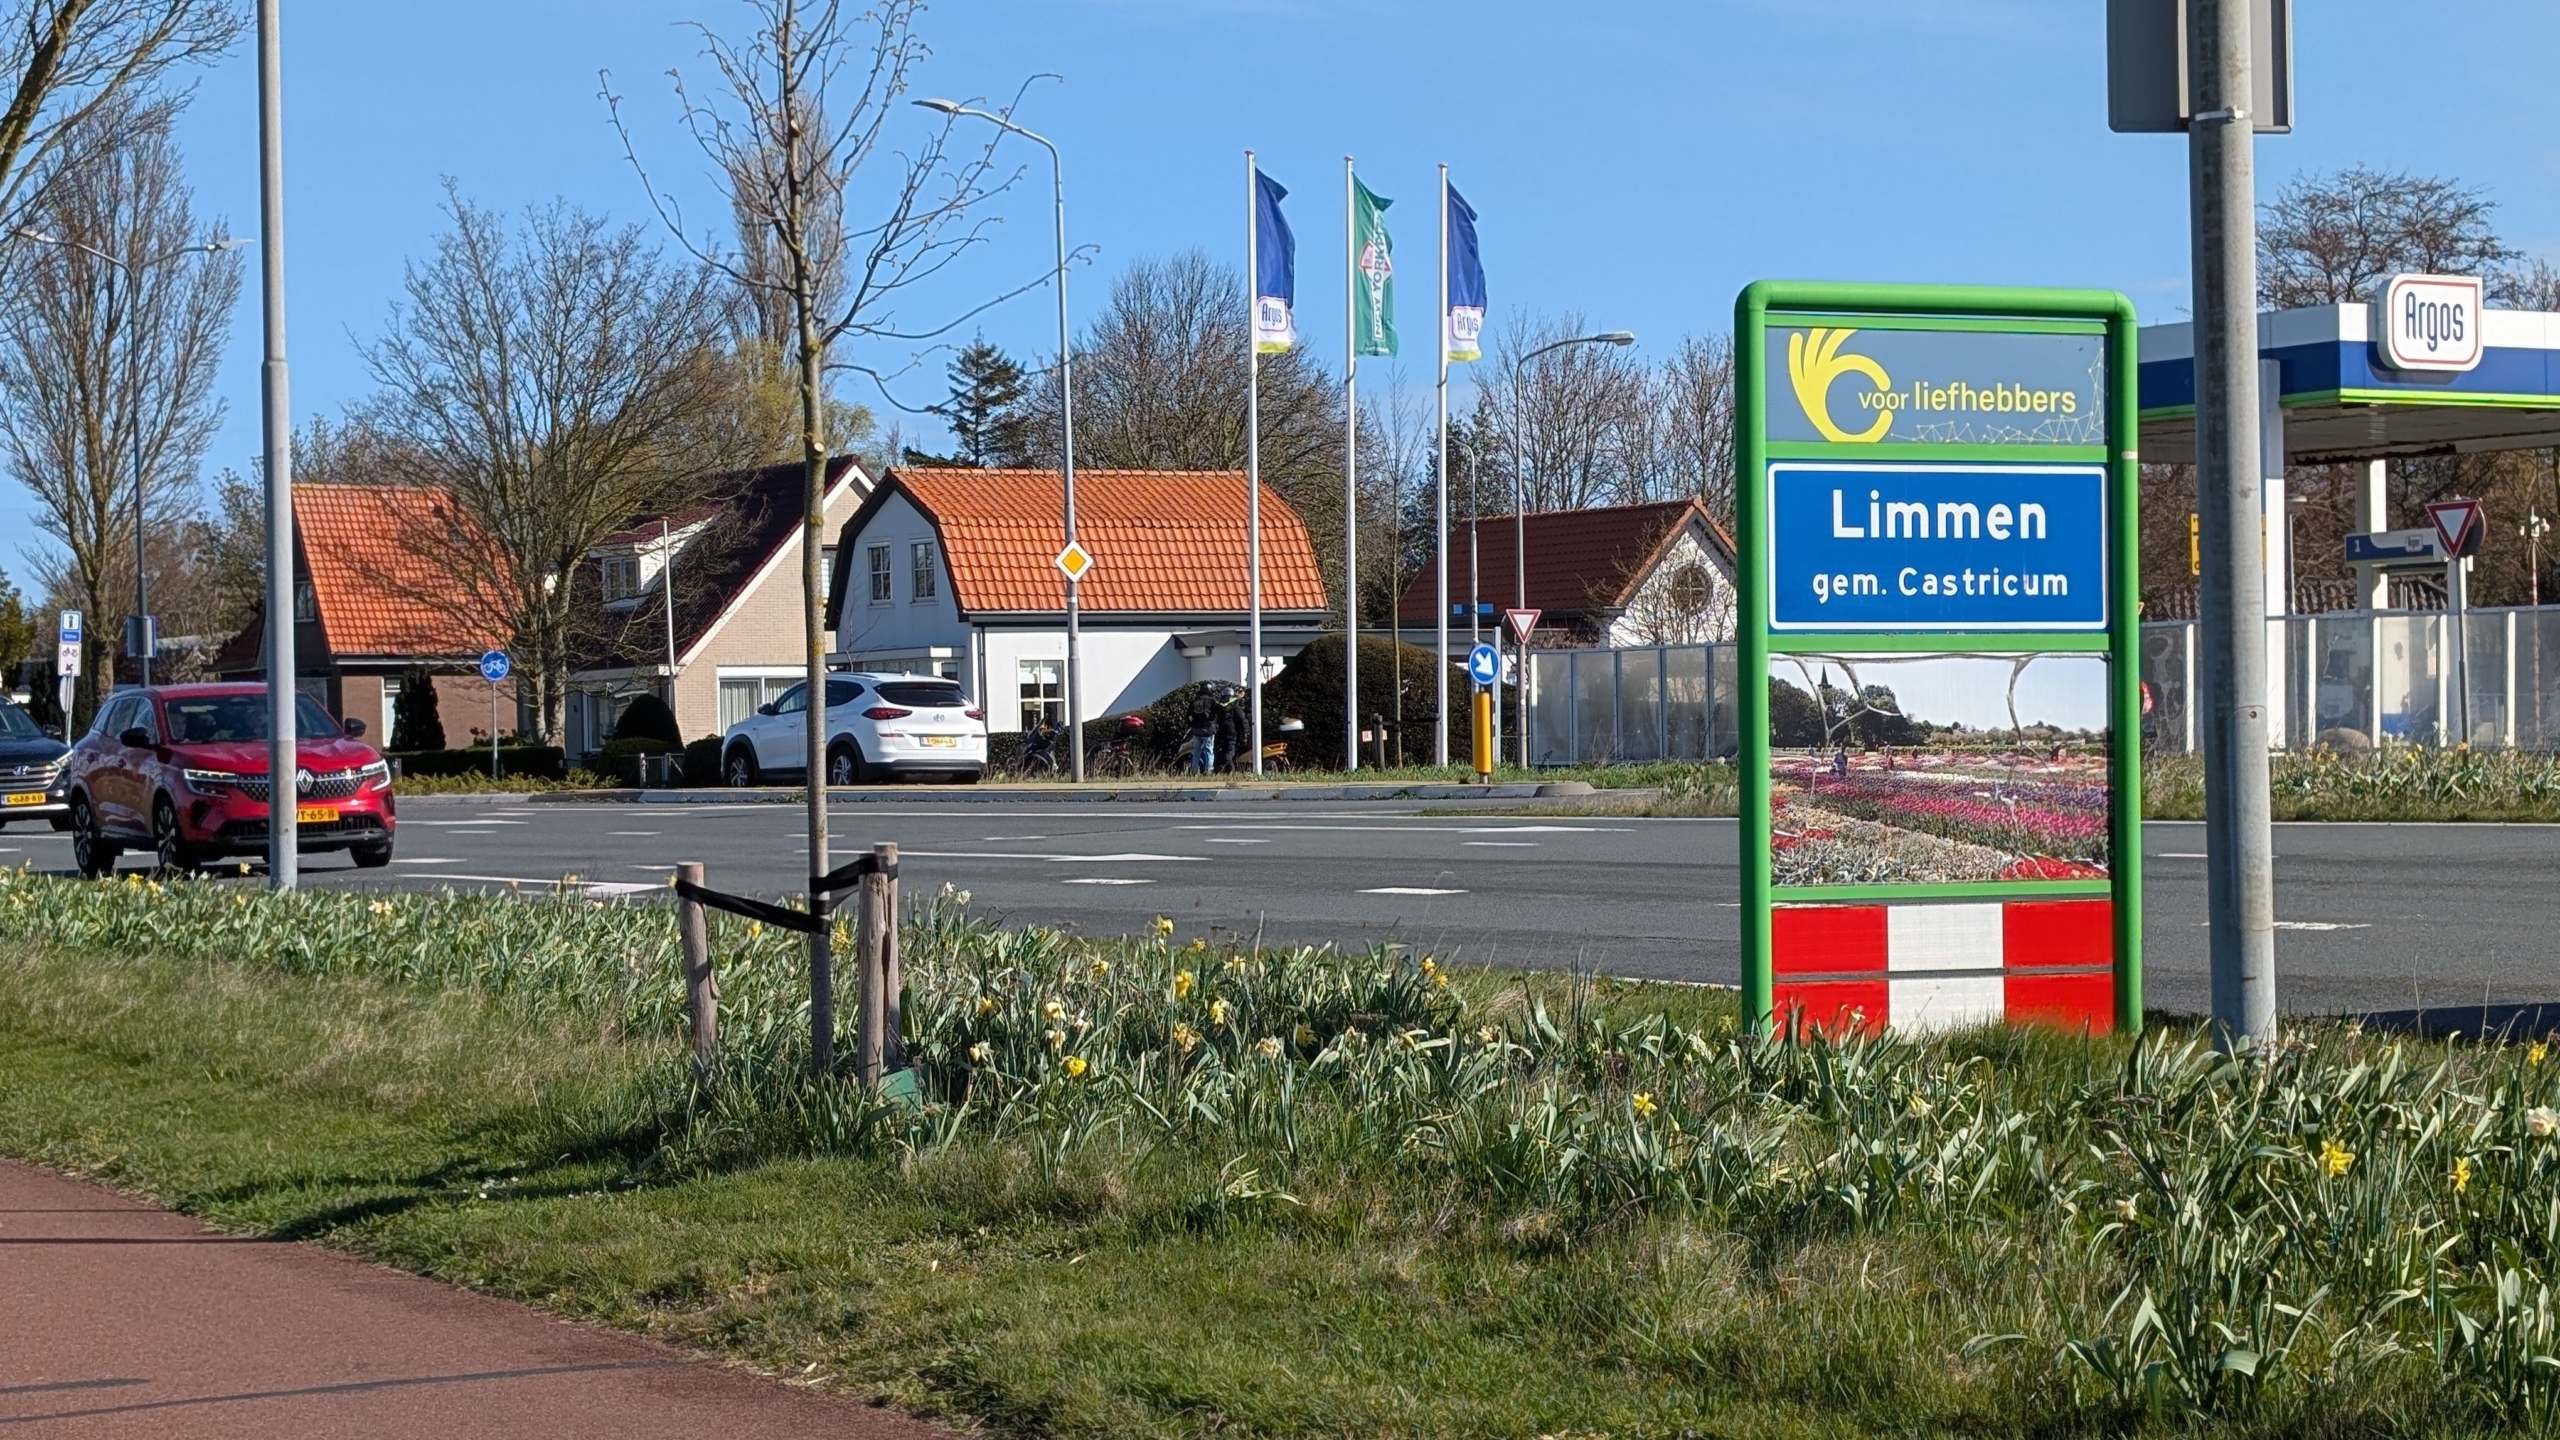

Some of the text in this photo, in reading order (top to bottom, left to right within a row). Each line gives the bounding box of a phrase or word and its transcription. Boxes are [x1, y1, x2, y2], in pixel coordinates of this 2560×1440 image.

[1373, 247, 1384, 293] YORK
[2405, 291, 2464, 352] Argos
[1858, 381, 2077, 413] voor liefhebbers
[1831, 488, 2048, 541] Limmen
[2354, 539, 2361, 553] 1
[1812, 566, 2069, 604] gem. Castricum
